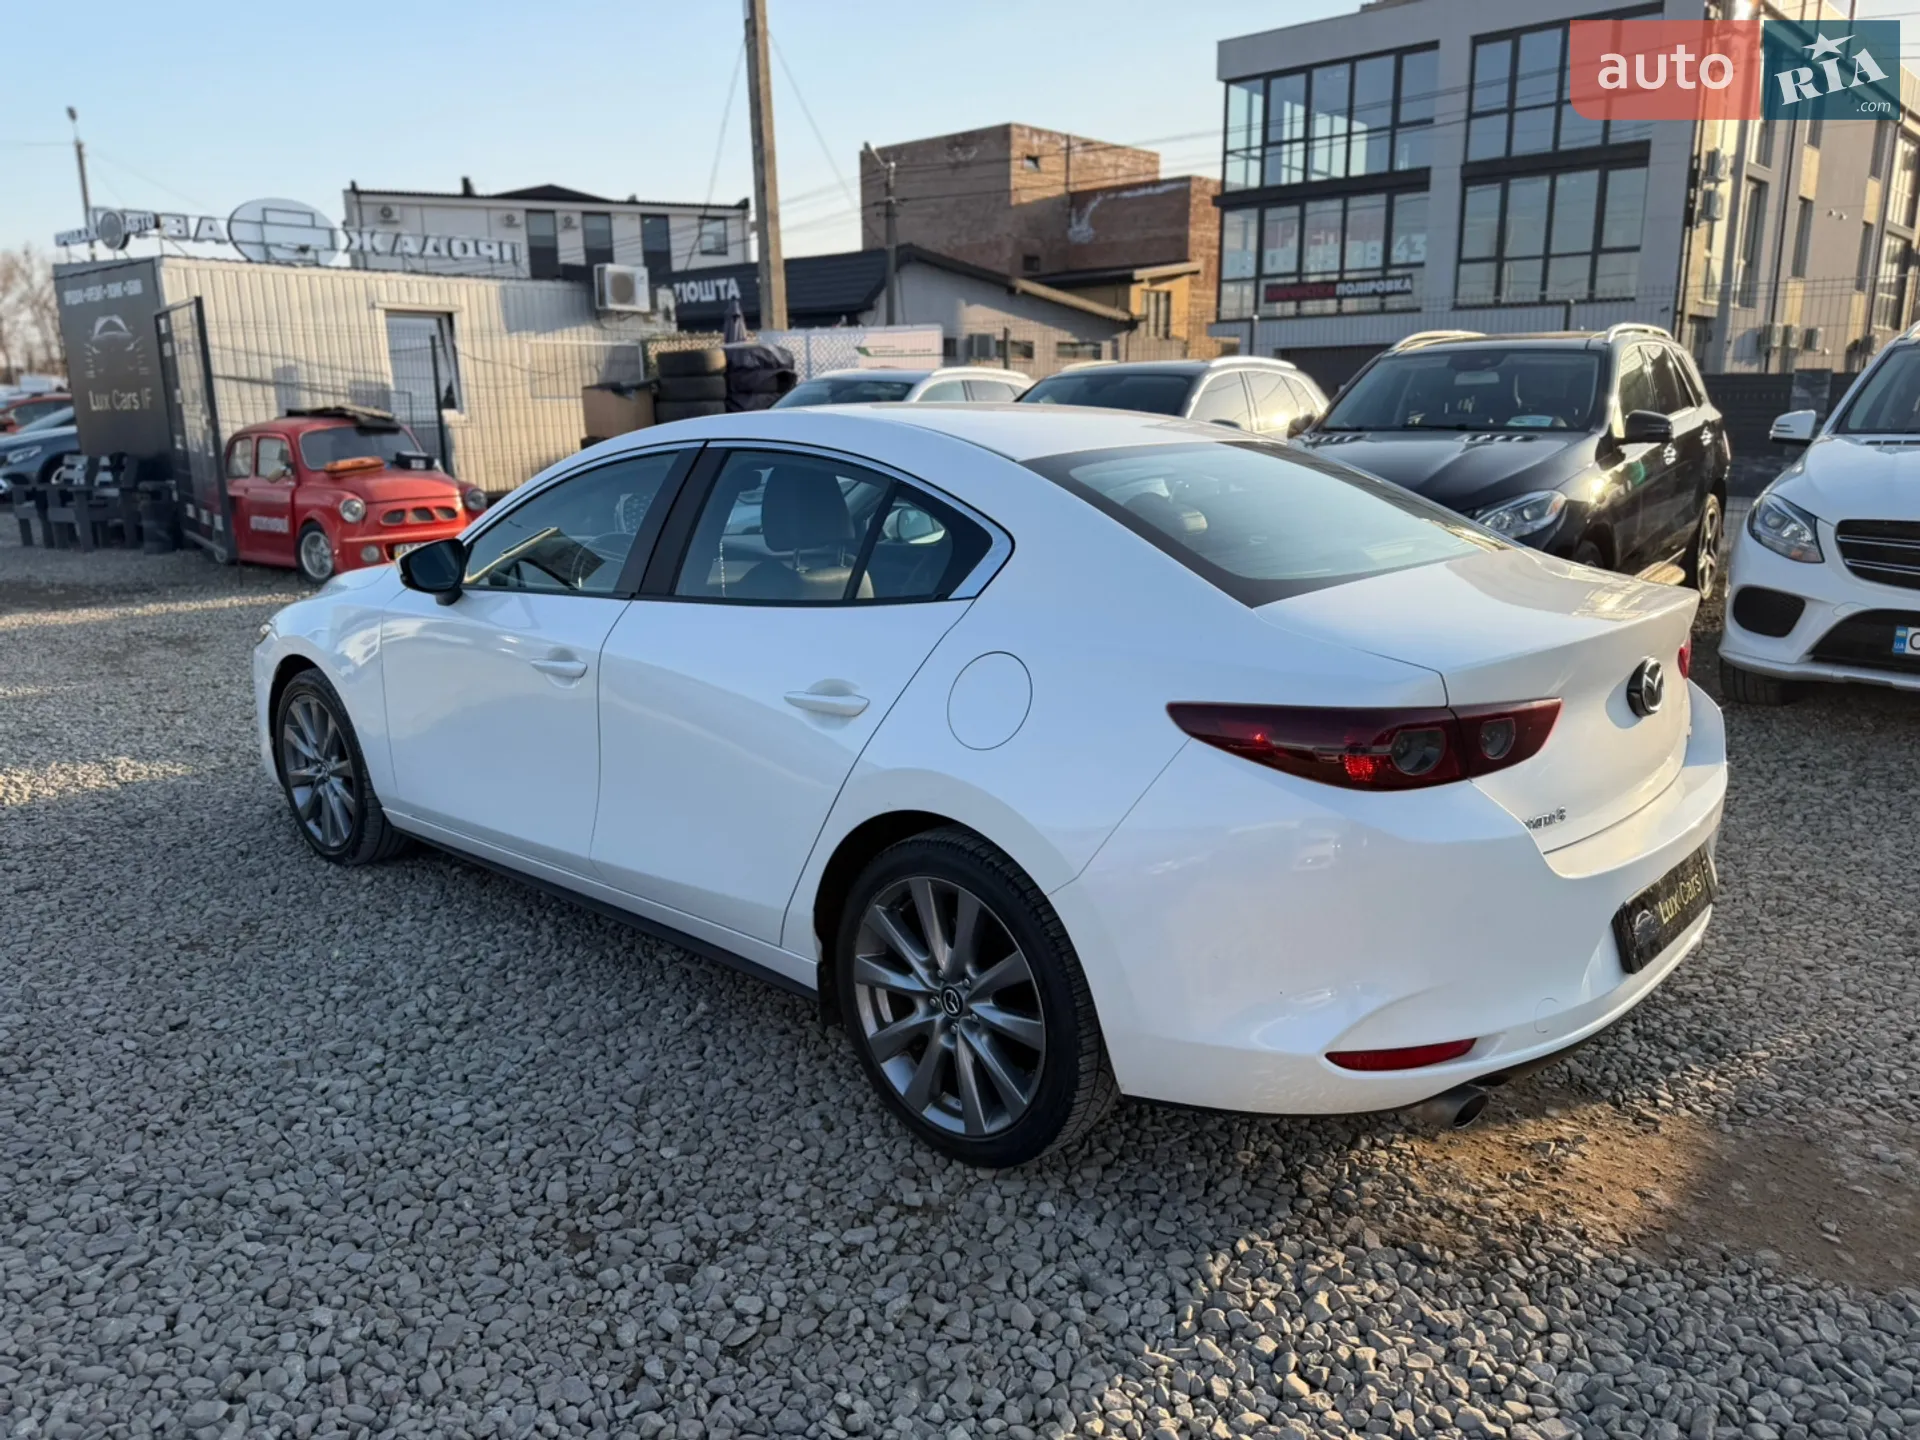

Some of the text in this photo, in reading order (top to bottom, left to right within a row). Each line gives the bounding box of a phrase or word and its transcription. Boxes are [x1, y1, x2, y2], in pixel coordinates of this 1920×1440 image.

[1336, 278, 1412, 296] ПОЛІРОВКА
[88, 390, 111, 411] Lux
[112, 388, 139, 411] Cars
[1658, 873, 1702, 924] Lux Cars
